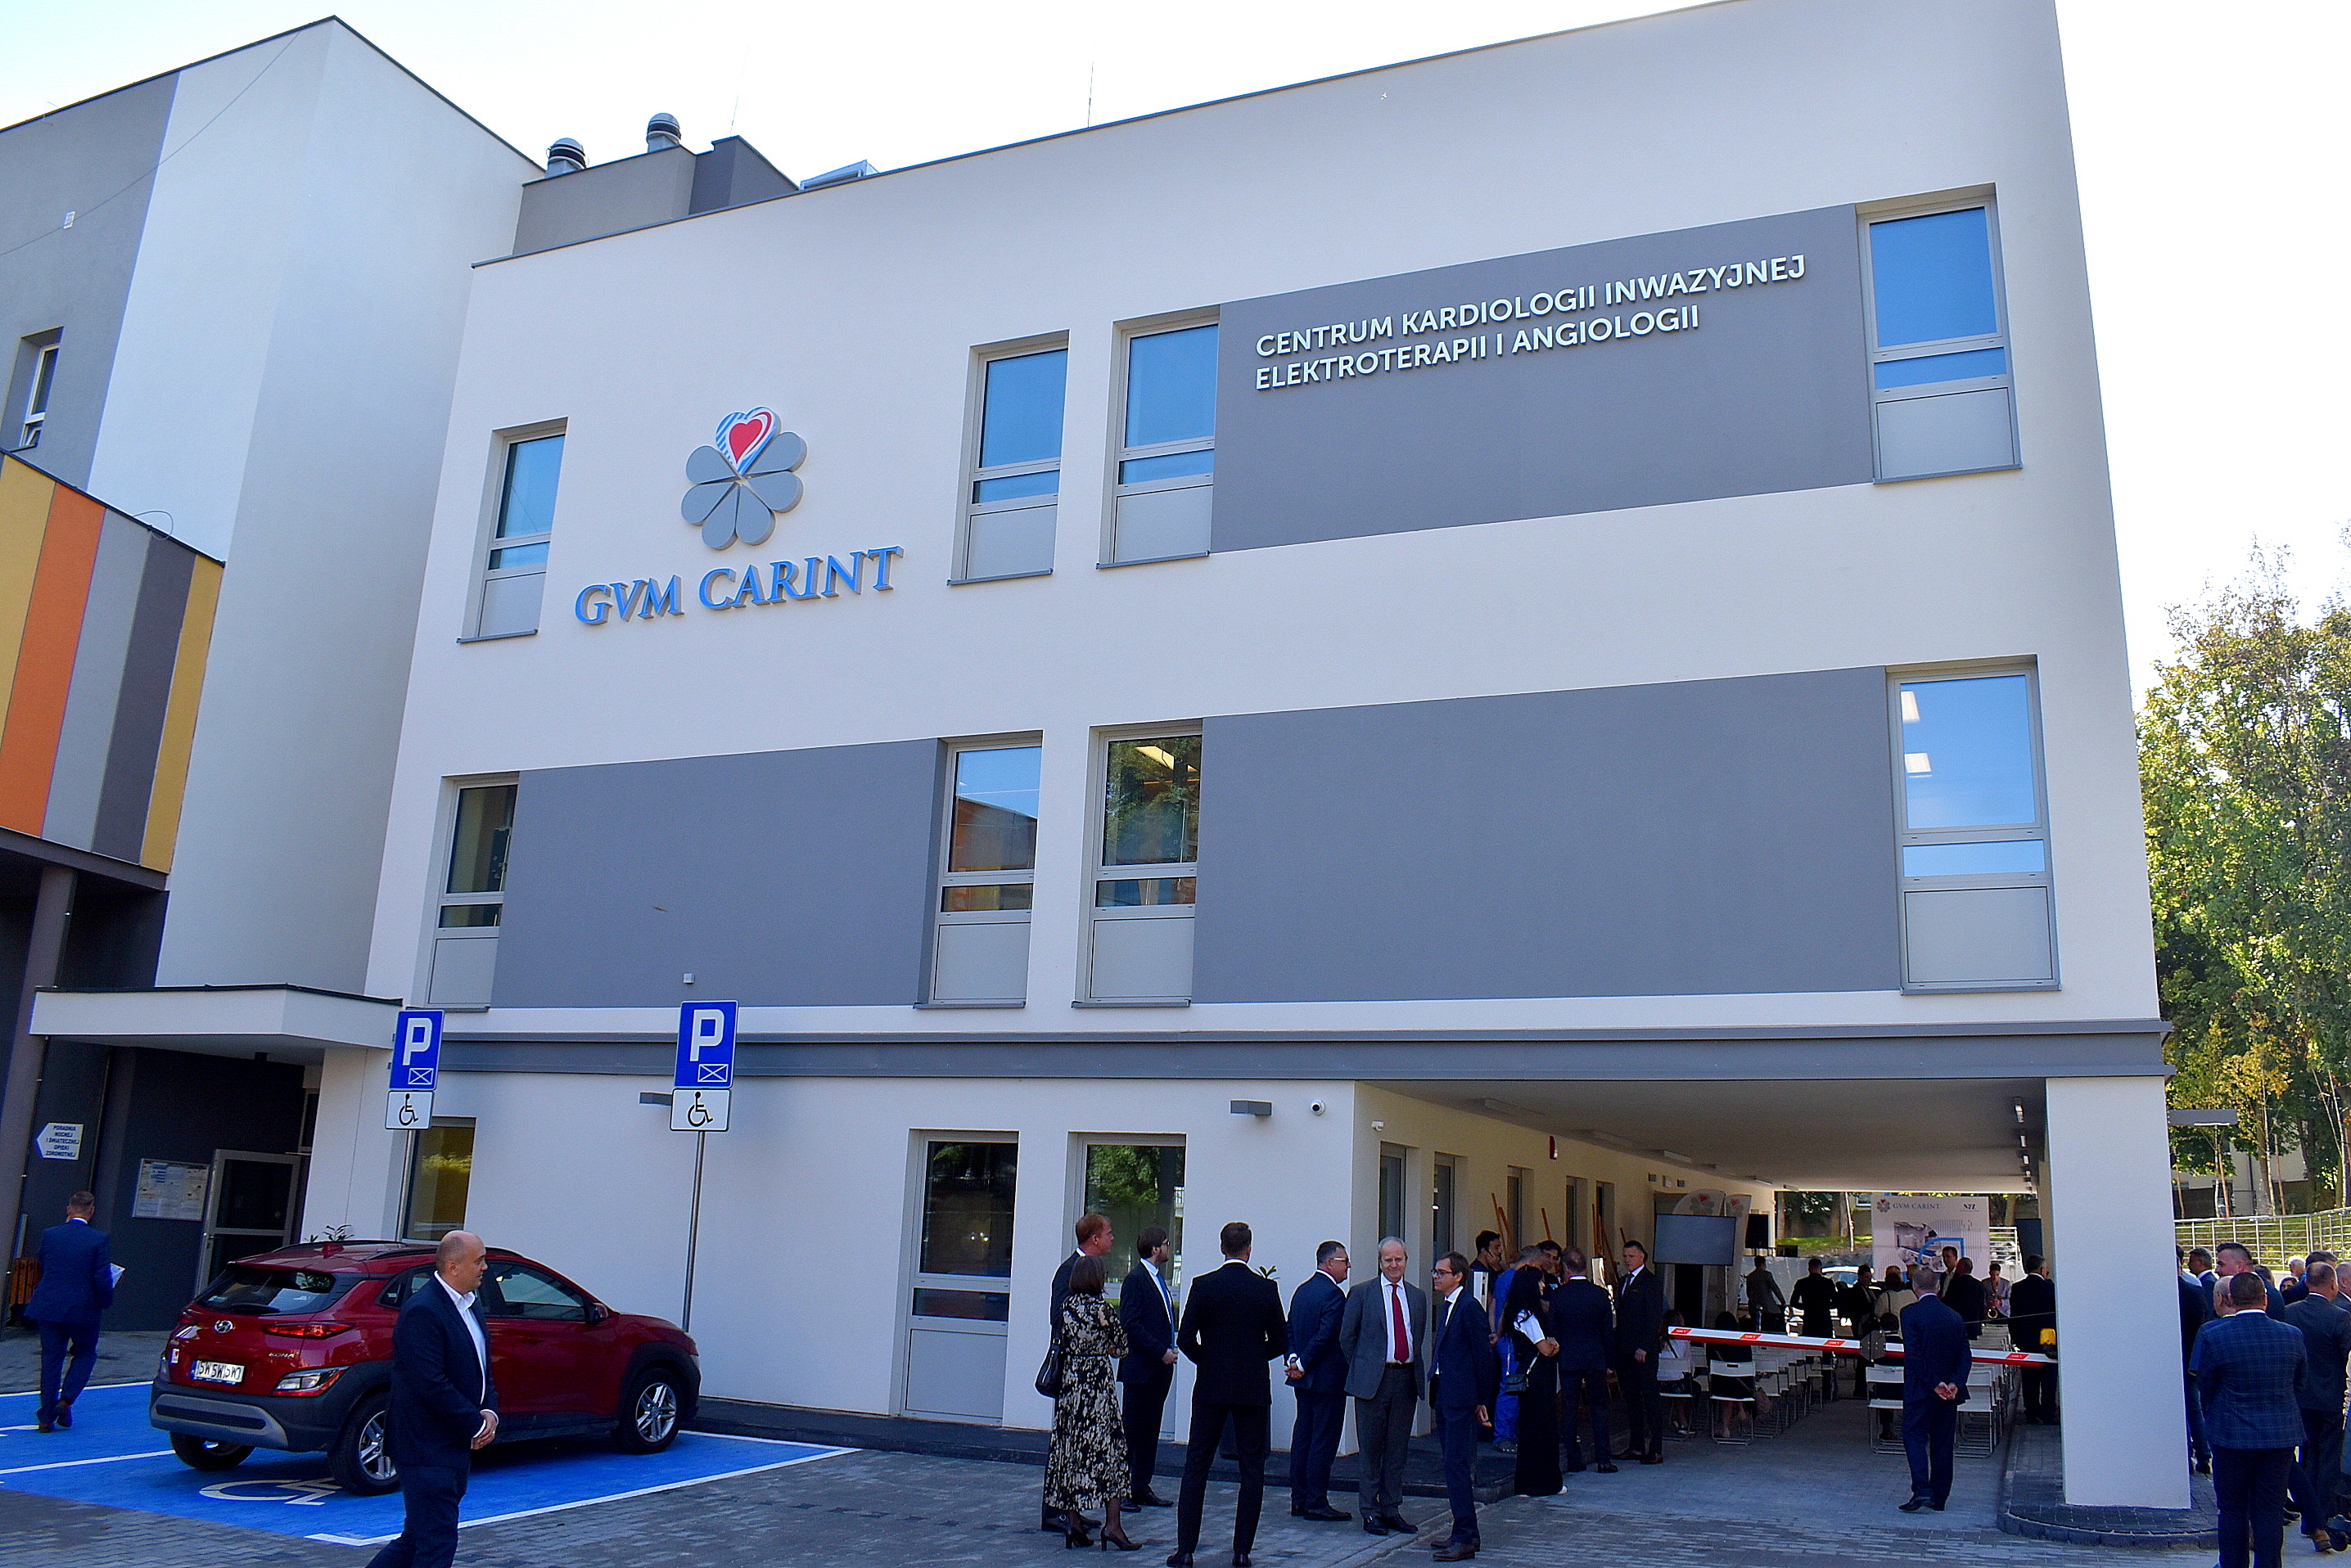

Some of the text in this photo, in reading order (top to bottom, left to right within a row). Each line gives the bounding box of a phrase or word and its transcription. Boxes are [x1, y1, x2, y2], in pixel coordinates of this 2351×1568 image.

[1256, 255, 1806, 358] CENTRUM KARDIOLOGII INWAZYJNEJ
[1256, 304, 1699, 390] ELEKTROTERAPII I ANGIOLOGII
[575, 545, 905, 625] GVM CARINT
[402, 1017, 432, 1066] P
[689, 1009, 724, 1062] P
